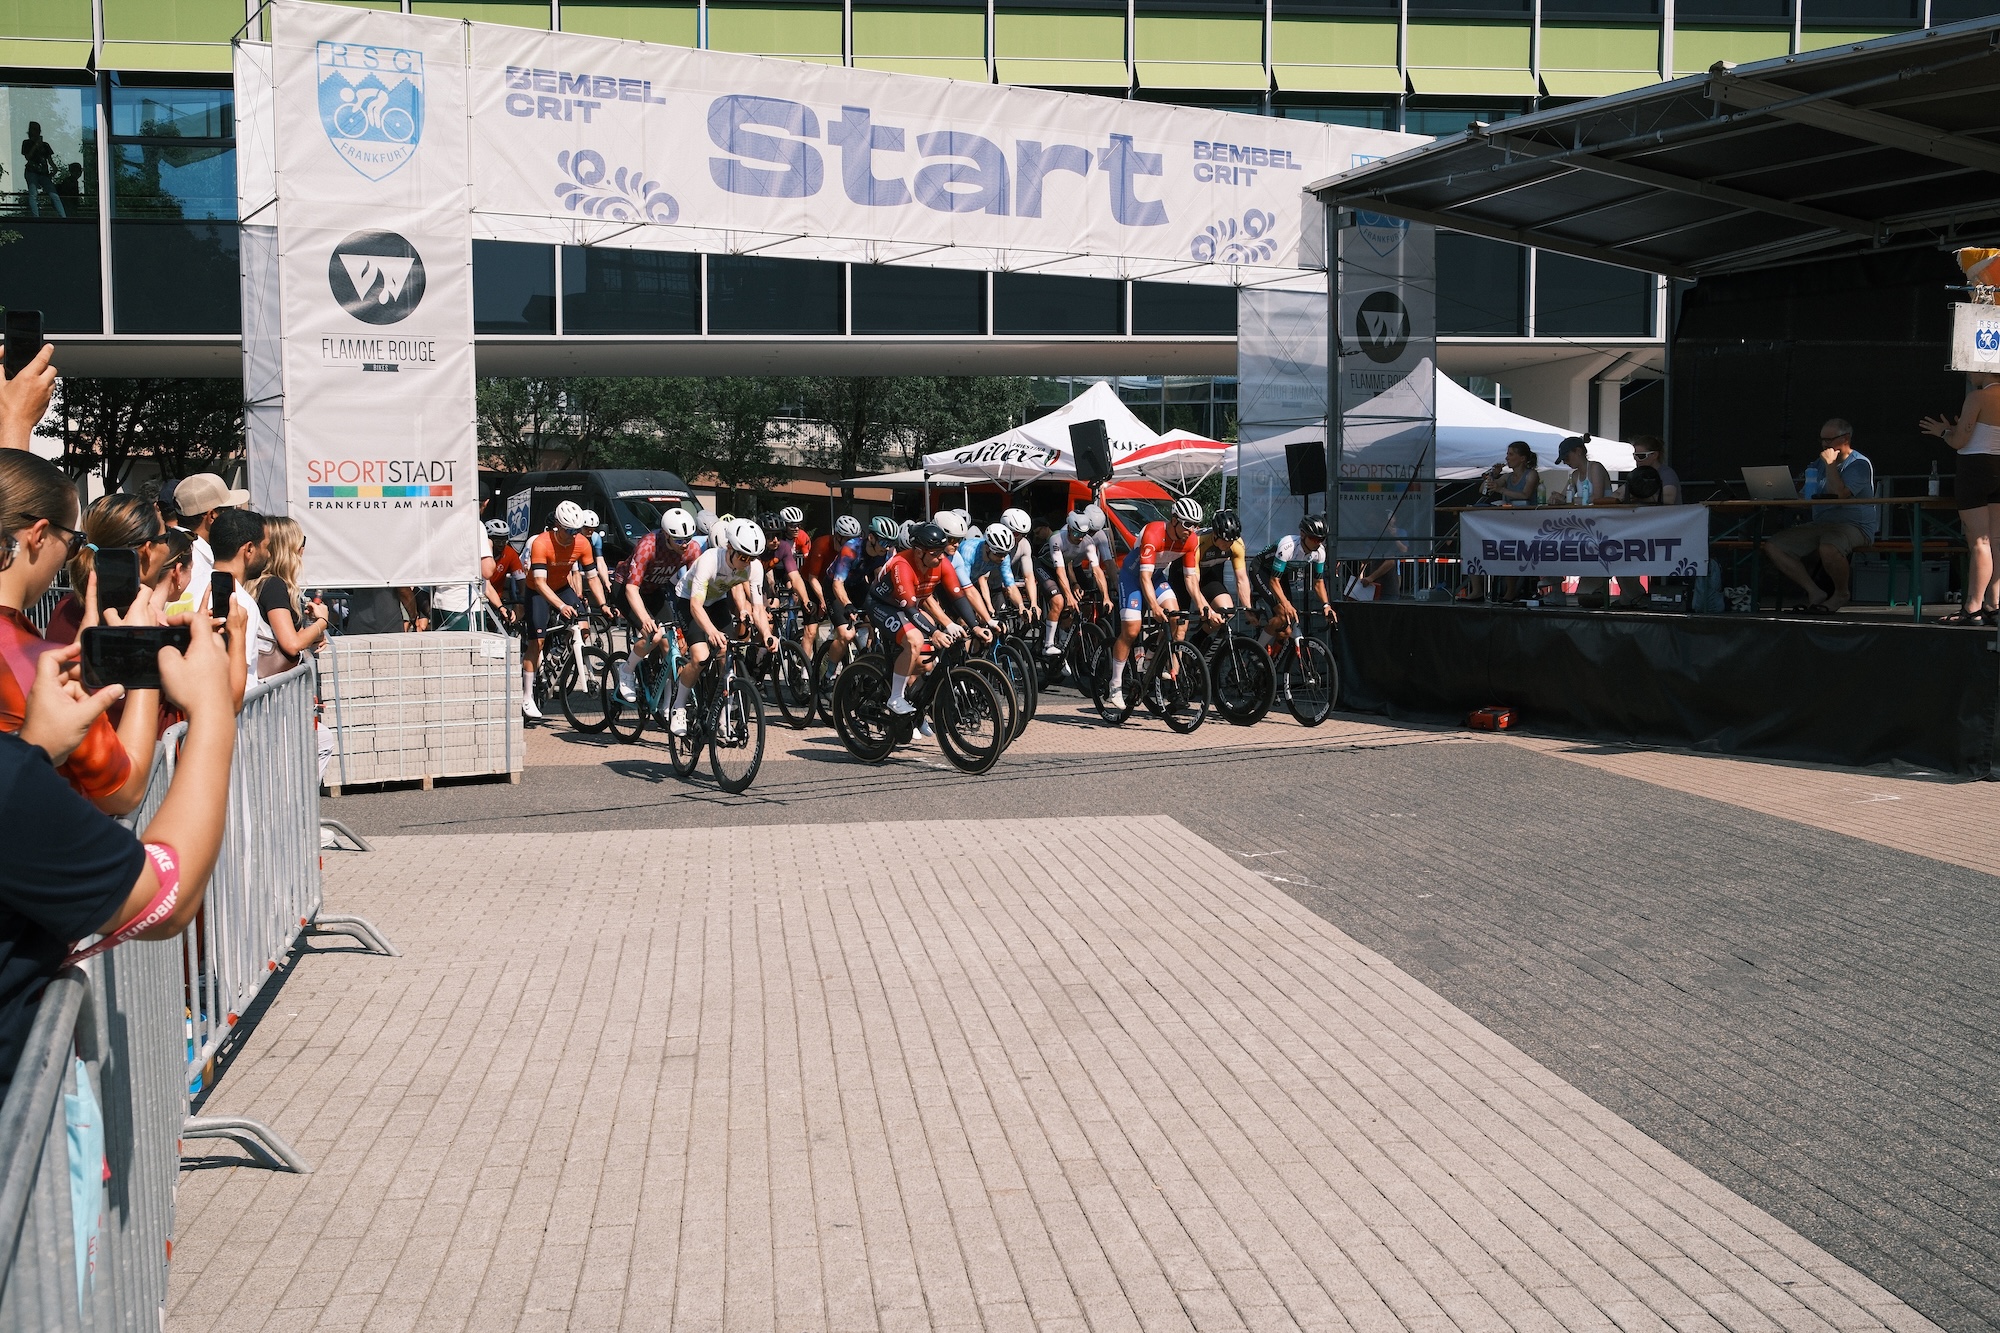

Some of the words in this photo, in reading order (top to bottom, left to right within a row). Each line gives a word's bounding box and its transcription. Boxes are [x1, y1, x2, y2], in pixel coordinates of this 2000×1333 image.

[330, 43, 413, 73] RSG
[505, 65, 667, 105] BEMBEL
[505, 93, 601, 123] CRIT
[340, 141, 410, 163] FRANKFURT
[707, 94, 1169, 227] Start
[1193, 140, 1302, 171] BEMBEL
[1193, 162, 1258, 187] CRIT
[322, 338, 385, 360] FLAMME
[389, 341, 436, 362] ROUGE
[372, 364, 389, 372] BIKES
[1350, 373, 1386, 390] FLAMME
[1387, 374, 1415, 391] ROUGE
[1012, 442, 1046, 453] TRIESTINA
[307, 459, 457, 483] SPORTSTADT
[1340, 463, 1424, 479] SPORTSTADT
[308, 501, 388, 509] FRANKFURT
[394, 501, 413, 509] AM
[420, 500, 454, 508] MAIN
[1339, 493, 1384, 501] FRANKFURT
[1387, 493, 1398, 501] AM
[652, 565, 677, 575] TAN
[1204, 637, 1224, 666] NYON
